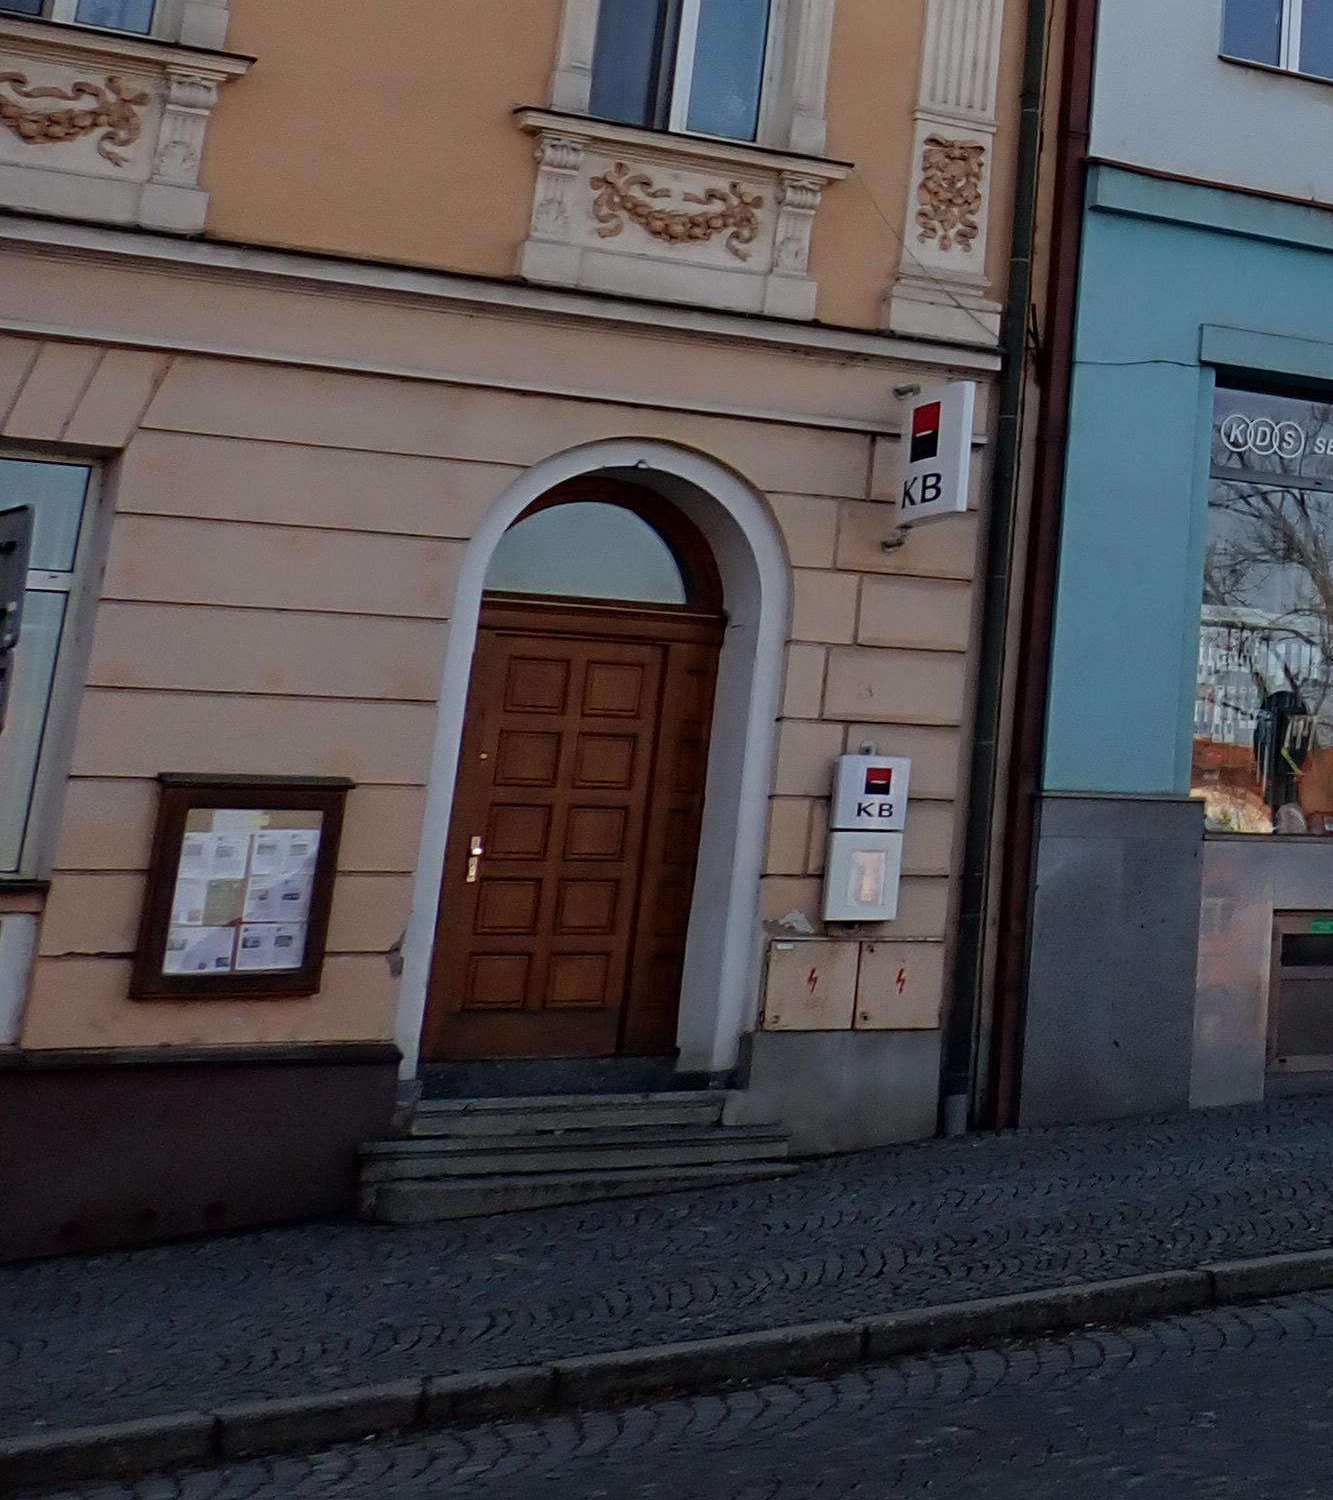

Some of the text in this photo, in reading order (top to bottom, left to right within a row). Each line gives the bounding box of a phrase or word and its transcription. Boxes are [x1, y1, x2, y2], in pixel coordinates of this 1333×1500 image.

[1227, 419, 1298, 452] KDS
[900, 472, 942, 510] KB
[856, 802, 893, 818] KB
